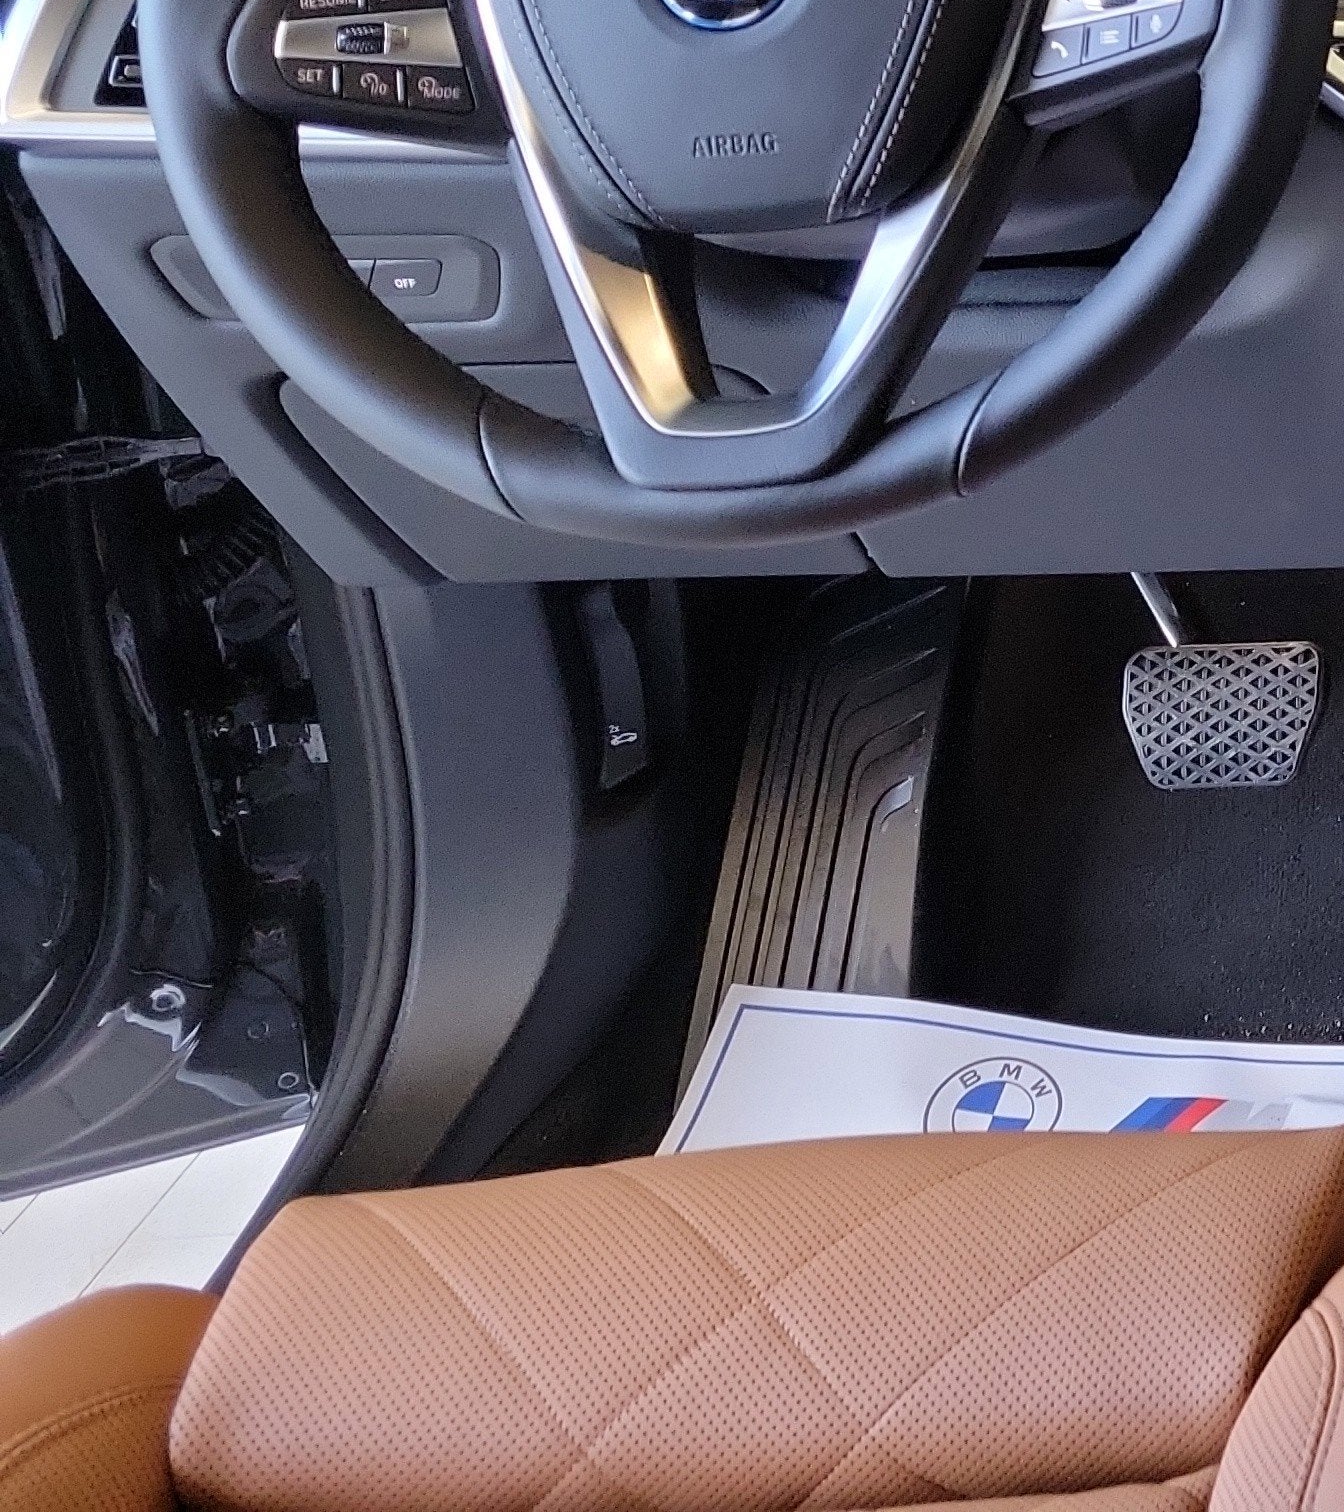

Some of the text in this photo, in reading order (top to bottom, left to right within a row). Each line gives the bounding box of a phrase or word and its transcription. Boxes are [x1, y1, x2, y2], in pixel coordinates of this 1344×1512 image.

[297, 69, 322, 84] SET
[693, 132, 779, 158] AIRBAG
[394, 278, 417, 289] OFF
[958, 1062, 1053, 1099] BMW
